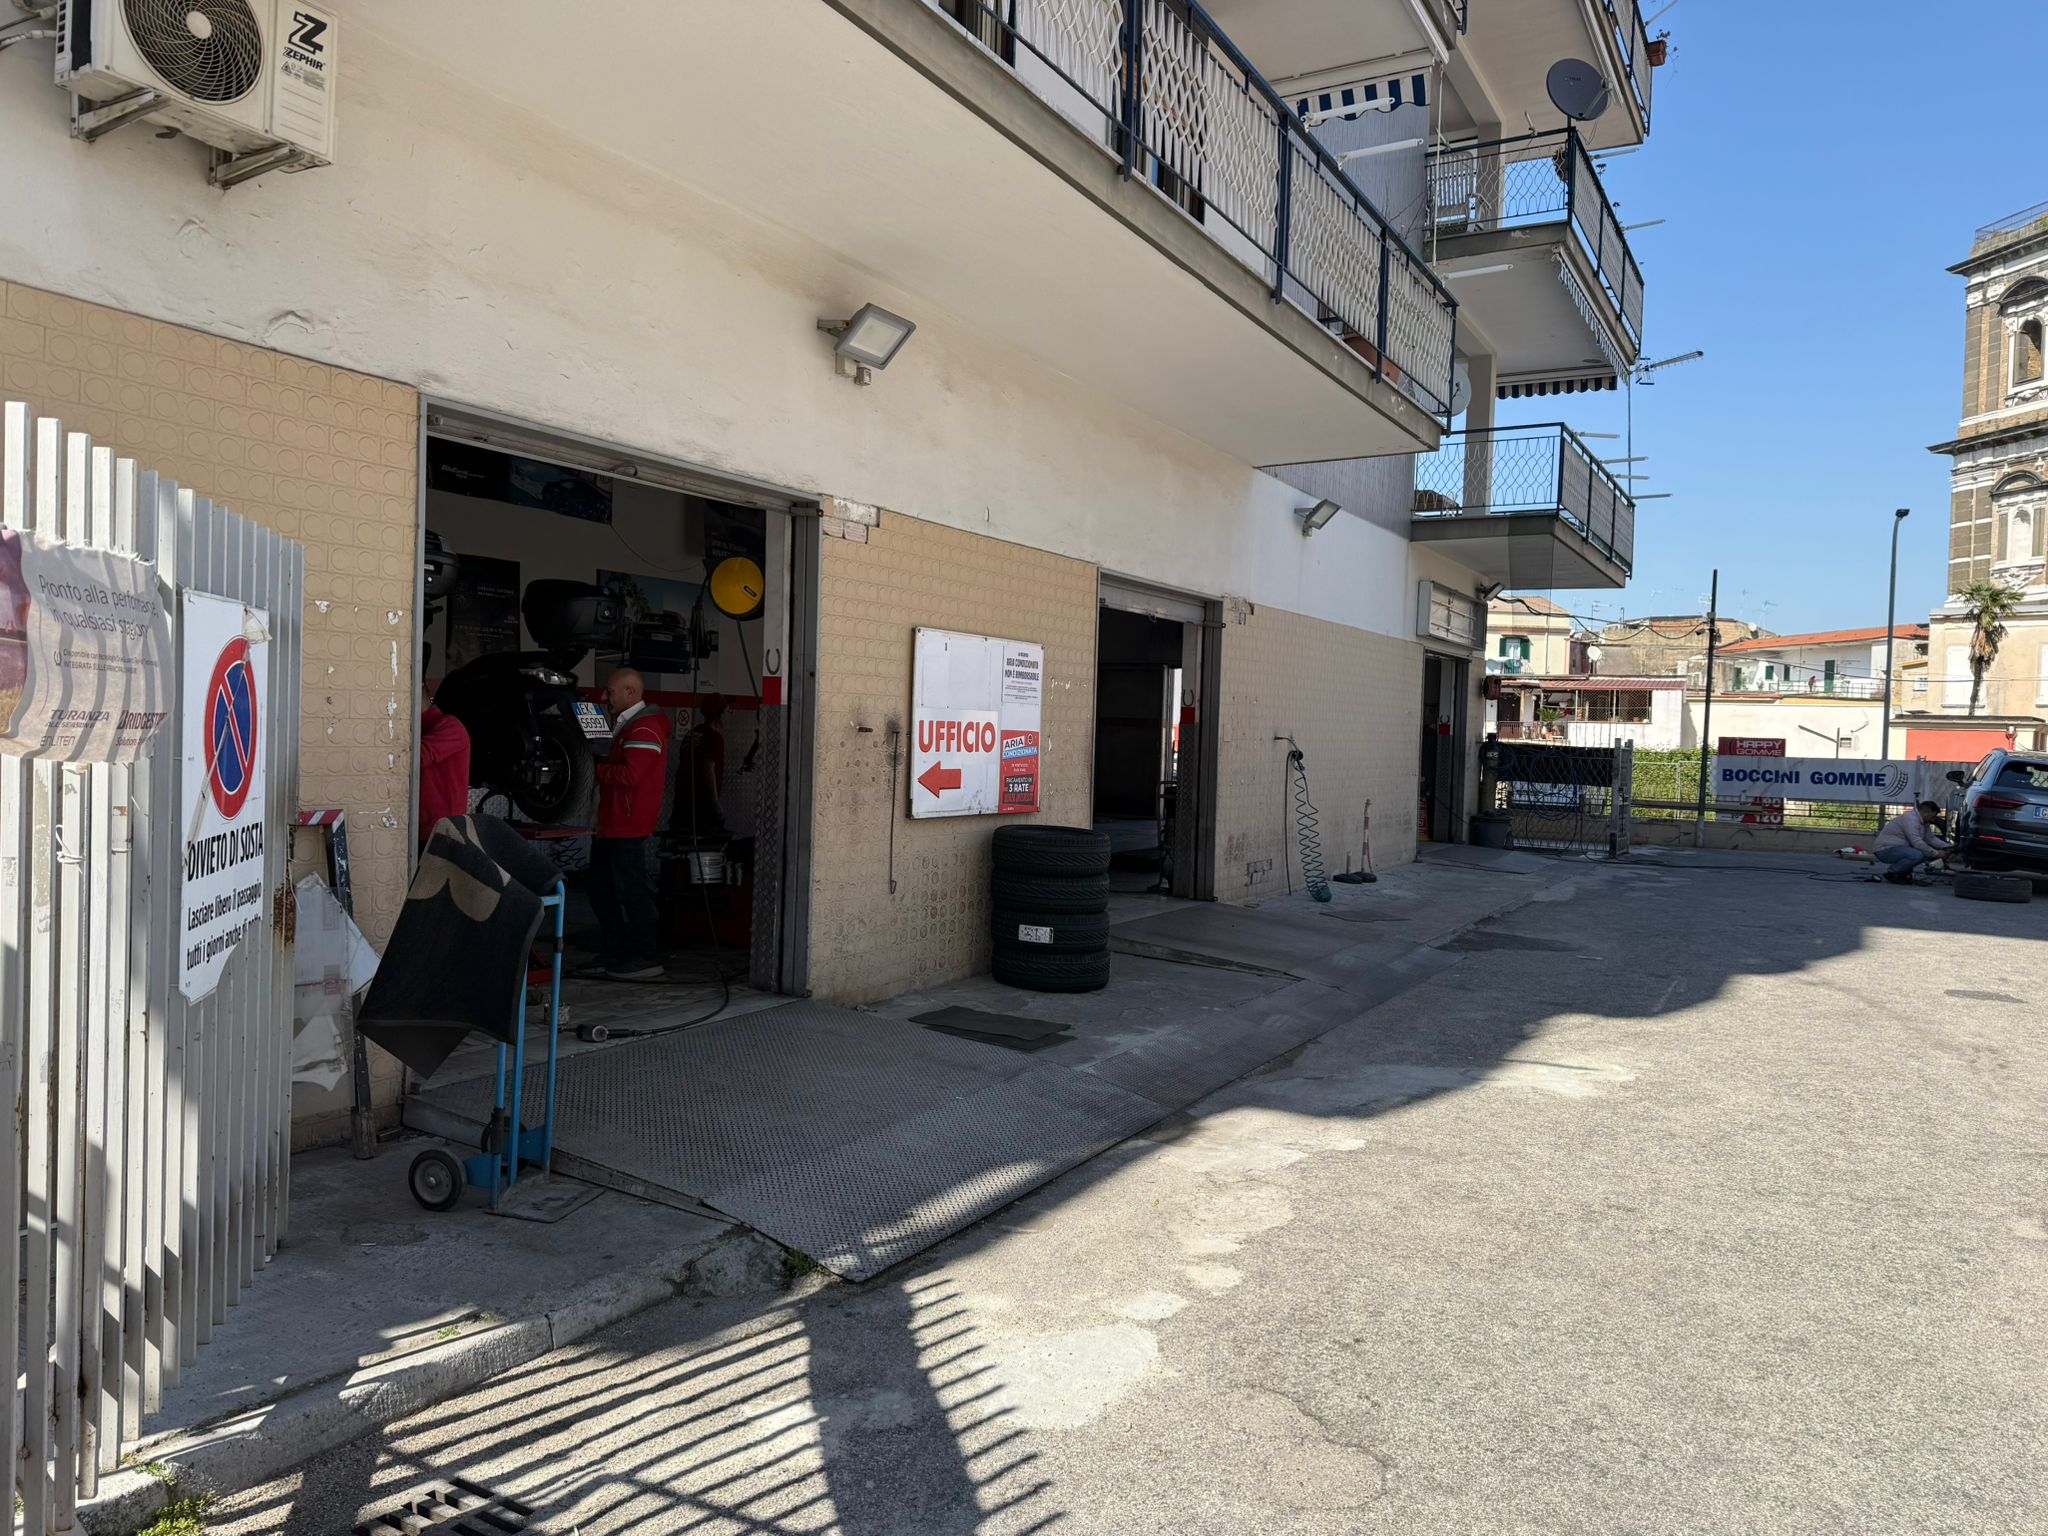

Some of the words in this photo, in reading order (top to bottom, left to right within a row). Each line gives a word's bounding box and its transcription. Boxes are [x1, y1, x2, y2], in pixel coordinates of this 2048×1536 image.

[283, 47, 324, 72] ZEPHIR
[39, 574, 82, 601] Pronto
[84, 584, 108, 605] alla
[63, 609, 117, 632] qualsiasi
[119, 619, 149, 641] stagion
[51, 709, 110, 721] TURANZA
[117, 709, 167, 730] BRIDGEST
[918, 719, 996, 753] UFFICIO
[1004, 738, 1024, 750] ARIA
[1736, 740, 1782, 749] HAPPY
[1002, 747, 1038, 758] CONDIZIONATA
[1008, 784, 1013, 792] 3
[1014, 783, 1029, 792] RATE
[1722, 768, 1800, 784] BOCCINI
[1810, 771, 1887, 787] GOMME
[187, 832, 228, 882] DIVIETO
[229, 828, 239, 868] DI
[240, 821, 263, 863] SOSTA
[188, 901, 214, 931] Lasciare
[214, 894, 231, 919] libero
[232, 887, 237, 911] il
[237, 878, 262, 912] passaggio
[187, 940, 202, 971] tutti
[202, 938, 206, 962] i
[206, 929, 225, 964] giorni
[225, 923, 241, 950] anche
